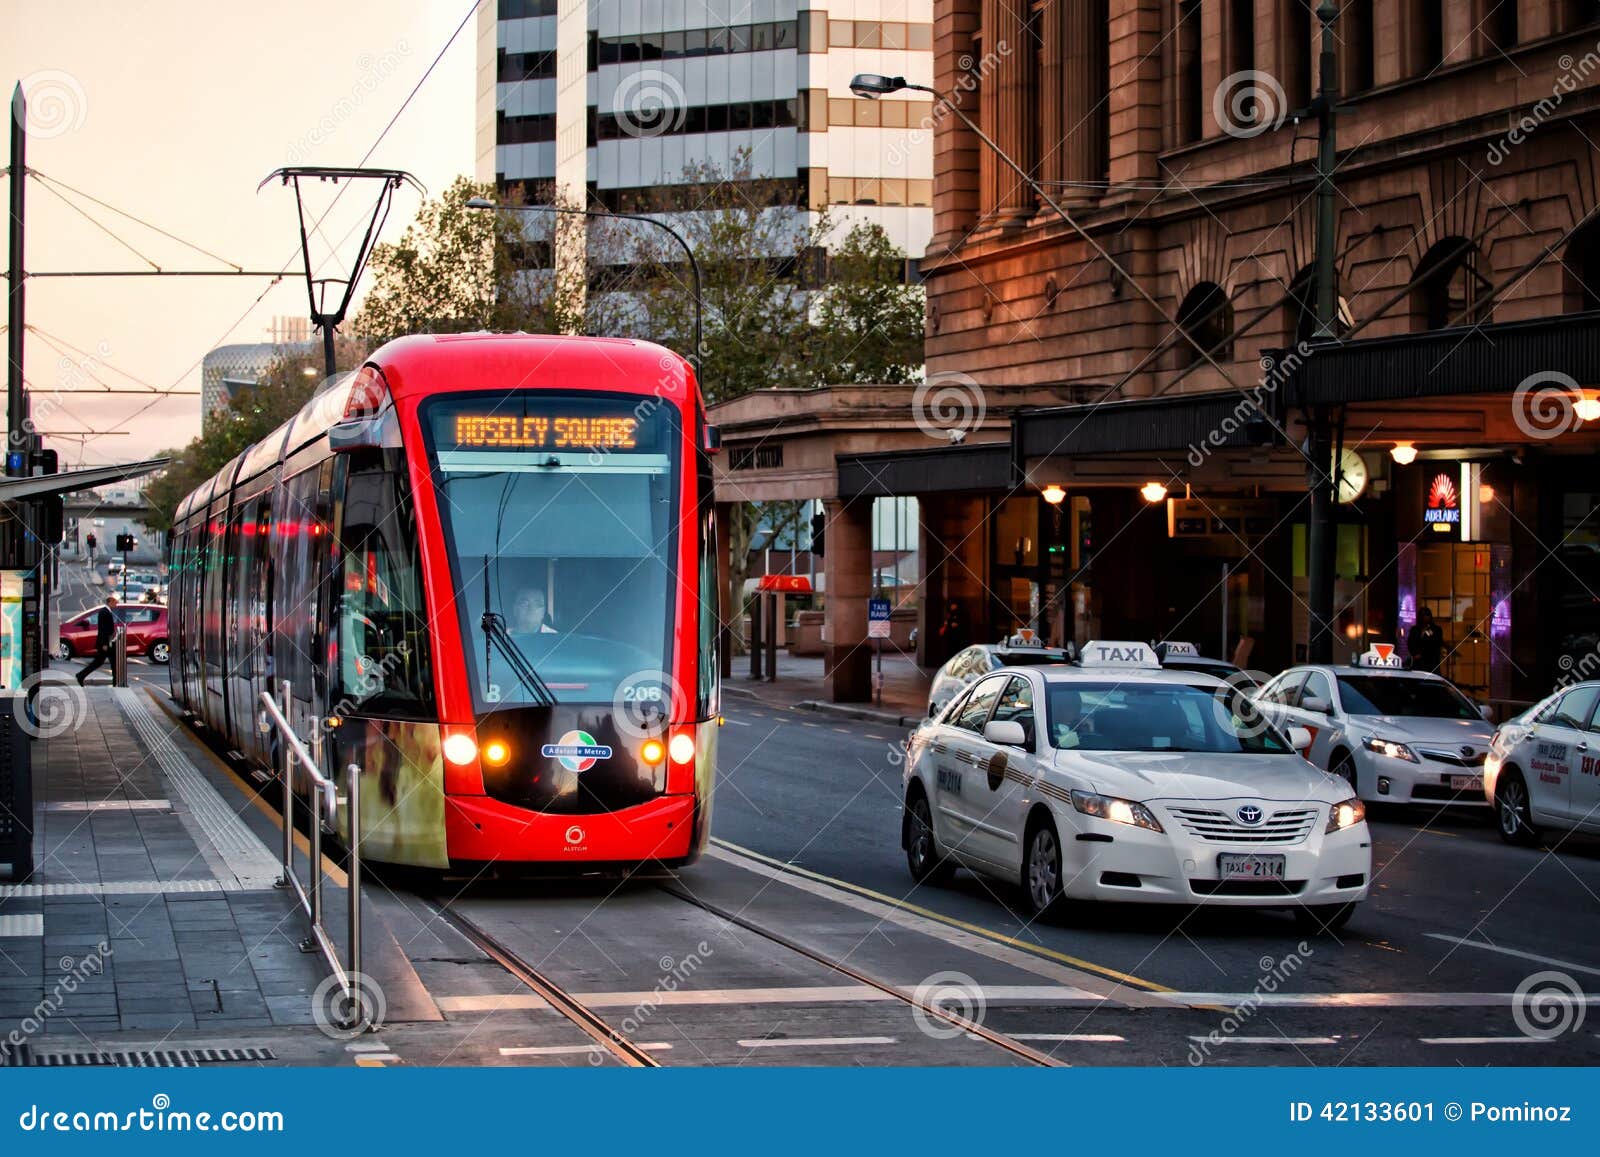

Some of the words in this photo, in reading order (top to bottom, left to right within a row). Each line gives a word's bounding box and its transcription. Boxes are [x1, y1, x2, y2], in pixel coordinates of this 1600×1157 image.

[457, 416, 548, 446] MOSELEY
[554, 418, 636, 448] SQUARE
[1424, 509, 1459, 522] ADELAIDE
[1097, 647, 1144, 661] TAXI
[1167, 645, 1190, 653] TAXI
[1368, 656, 1400, 667] TAXI
[549, 747, 582, 755] Adelaide
[1225, 862, 1245, 873] TAXI
[1254, 862, 1283, 876] 2114
